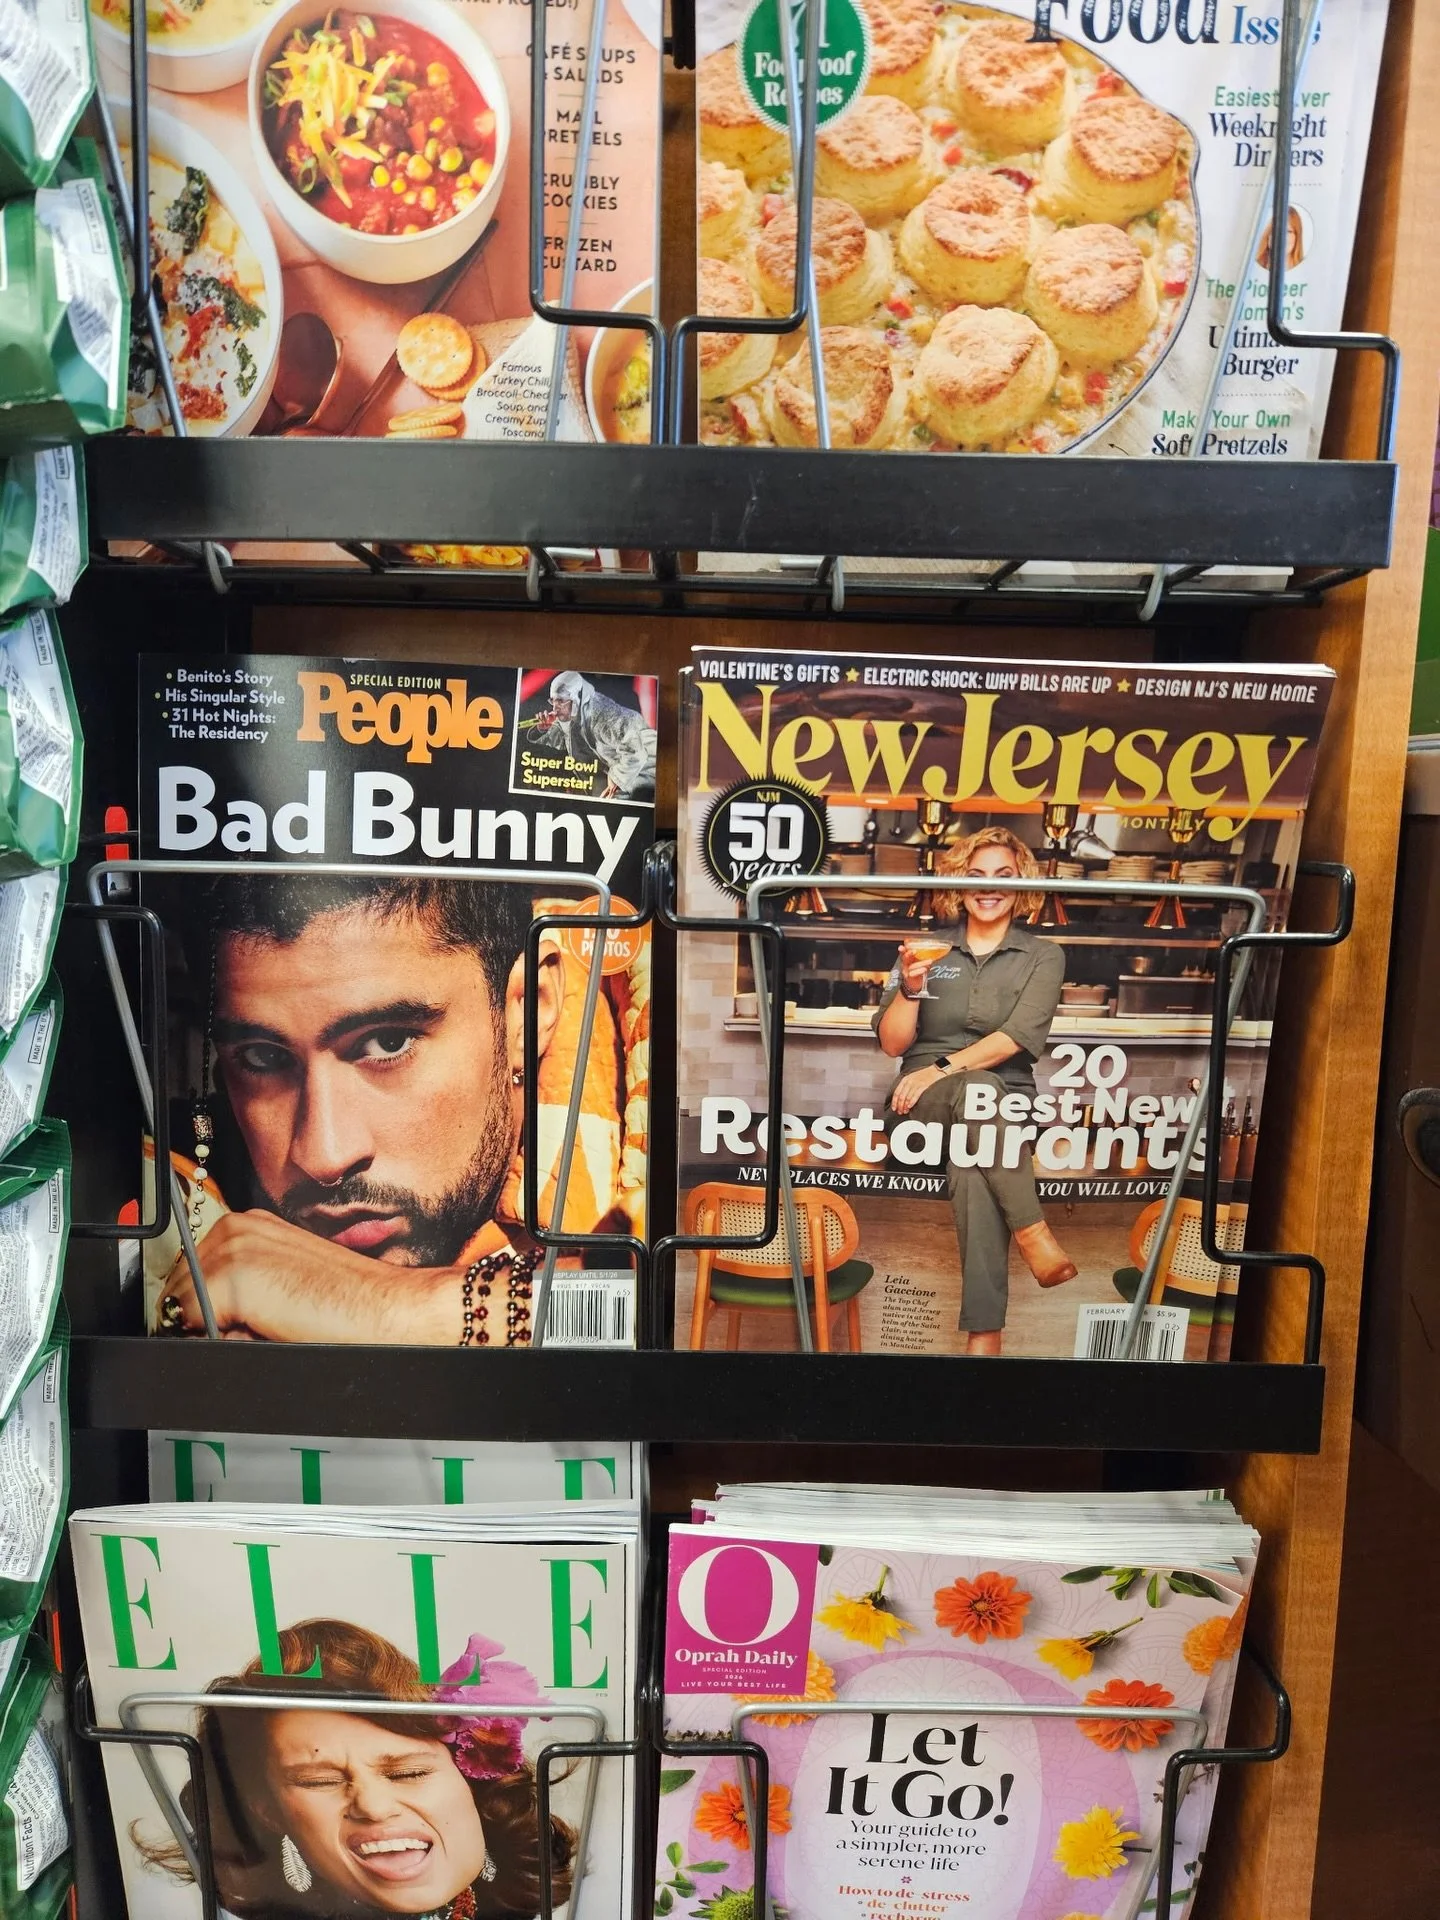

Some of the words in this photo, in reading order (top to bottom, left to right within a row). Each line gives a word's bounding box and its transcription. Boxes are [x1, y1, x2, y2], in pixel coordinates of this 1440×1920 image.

[1025, 0, 1220, 45] Food
[1230, 5, 1320, 45] Iss
[526, 42, 571, 60] CFÉ
[576, 46, 636, 63] SUPS
[554, 66, 624, 84] SALDS
[754, 50, 856, 83] Fopoof
[764, 81, 843, 107] Rees
[1215, 86, 1280, 108] Easiest
[1295, 91, 1330, 108] ver
[557, 110, 602, 125] MAL
[543, 129, 622, 146] RETELS
[1208, 112, 1327, 145] Weeknght
[1233, 142, 1324, 167] Diners
[543, 174, 620, 190] CRUBLY
[543, 237, 613, 252] FRZEN
[543, 256, 617, 272] CUTARD
[1207, 279, 1235, 298] The
[1246, 279, 1308, 298] ioeer
[1238, 301, 1304, 321] omn's
[1209, 325, 1284, 349] Utima
[501, 362, 542, 373] Famous
[1223, 353, 1299, 382] Burger
[493, 375, 526, 387] Turkey
[527, 403, 548, 412] and
[485, 414, 524, 426] Creamy
[526, 415, 560, 426] Zup
[1162, 410, 1197, 428] Mak
[1212, 410, 1249, 428] Your
[1256, 410, 1290, 428] Own
[502, 427, 545, 438] Toscana
[1152, 433, 1193, 456] Soft
[1201, 433, 1288, 456] Pretzels
[177, 669, 231, 684] Benito's
[234, 670, 273, 687] Story
[350, 674, 395, 688] SPECIAL
[398, 676, 441, 690] EDITION
[700, 660, 794, 682] VALENTINE'S
[797, 664, 840, 684] GIFTS
[864, 666, 931, 687] ELECTRIC
[931, 670, 983, 689] SHOCK:
[985, 672, 1018, 690] WHY
[1020, 673, 1059, 692] BILLS
[1061, 675, 1089, 693] ARE
[1091, 676, 1112, 694] UP
[1135, 678, 1190, 697] DESIGN
[1194, 680, 1229, 698] NJ'S
[1231, 681, 1267, 701] NEW
[1270, 683, 1318, 703] HOME
[166, 689, 187, 702] His
[190, 689, 247, 706] Singular
[249, 690, 286, 708] Style
[172, 708, 187, 722] 31
[193, 708, 220, 723] Hot
[223, 709, 277, 727] Nights:
[297, 671, 504, 764] People
[169, 725, 195, 739] The
[199, 726, 269, 743] Residency
[521, 751, 563, 771] Super
[564, 756, 598, 773] Bowl
[694, 681, 935, 798] New
[922, 692, 1308, 841] Jersey
[523, 769, 594, 790] Superstar!
[756, 791, 780, 803] NJM
[159, 765, 327, 854] Bad
[352, 771, 640, 884] Bunny
[728, 802, 805, 862] 50
[1117, 815, 1205, 832] MONTHLY
[722, 861, 802, 888] years
[581, 941, 631, 957] PHTOS
[32, 1044, 41, 1059] MADE
[1049, 1043, 1128, 1088] 20
[964, 1083, 1082, 1123] Best
[1092, 1087, 1199, 1124] New
[700, 1097, 1220, 1172] Restaurants
[789, 1170, 850, 1187] PLACES
[855, 1174, 884, 1189] WE
[888, 1176, 946, 1193] KNOW
[1038, 1182, 1075, 1197] YOU
[1078, 1181, 1121, 1197] WILL
[1125, 1181, 1171, 1197] LOVE
[884, 1274, 910, 1286] Leia
[884, 1285, 937, 1298] Gaccione
[898, 1297, 911, 1305] Top
[912, 1298, 931, 1308] Chef
[678, 1544, 799, 1646] O
[90, 1532, 609, 1690] ELLE
[675, 1648, 739, 1665] Oprah
[744, 1650, 799, 1668] Daily
[865, 1713, 989, 1767] Let
[21, 1792, 40, 1819] Calories
[825, 1766, 879, 1816] It
[891, 1769, 1015, 1826] Go!
[21, 1816, 33, 1841] Facts
[850, 1819, 897, 1834] Your
[898, 1823, 954, 1839] guide
[957, 1826, 977, 1838] to
[836, 1839, 848, 1850] a
[849, 1837, 928, 1855] simpler,
[933, 1842, 987, 1856] more
[23, 1841, 35, 1880] Nutrition
[858, 1856, 926, 1870] serene
[930, 1857, 960, 1871] life
[839, 1885, 874, 1896] How
[877, 1887, 893, 1897] to
